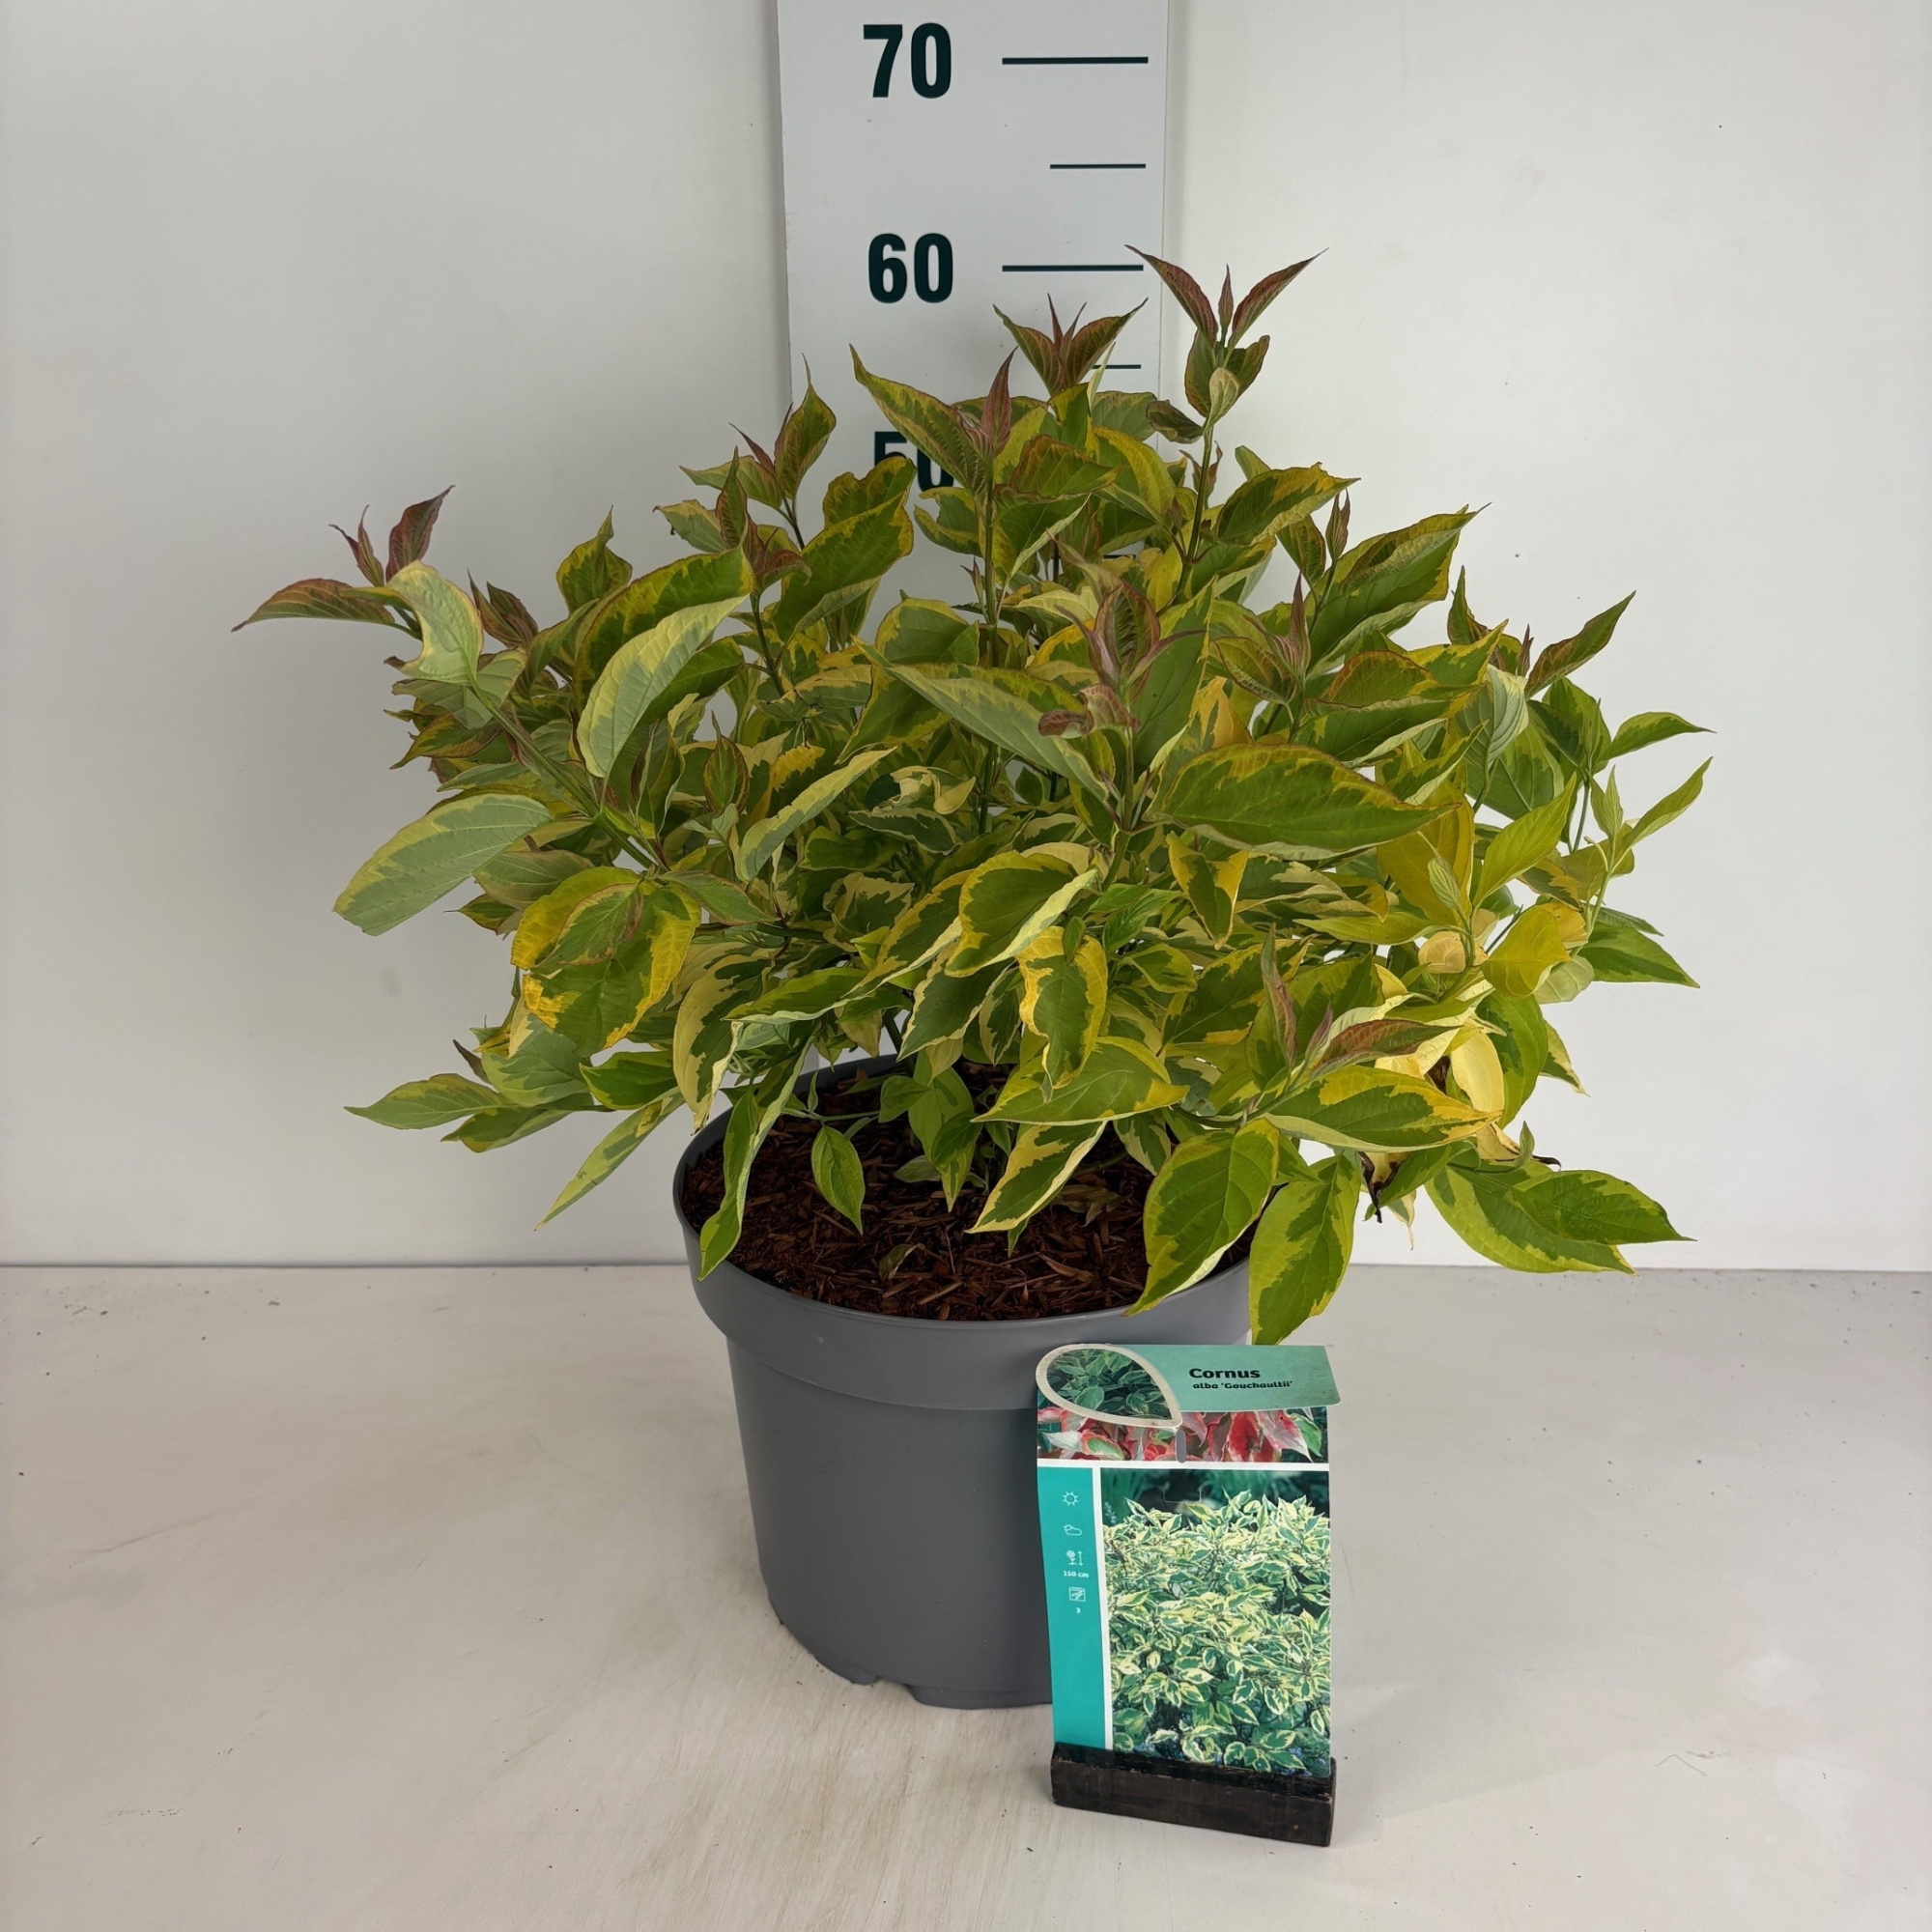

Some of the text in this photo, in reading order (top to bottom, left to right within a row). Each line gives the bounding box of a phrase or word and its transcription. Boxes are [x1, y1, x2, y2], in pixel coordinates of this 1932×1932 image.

[863, 22, 952, 99] 70
[867, 233, 953, 304] 60
[1189, 1368, 1261, 1378] Cornus
